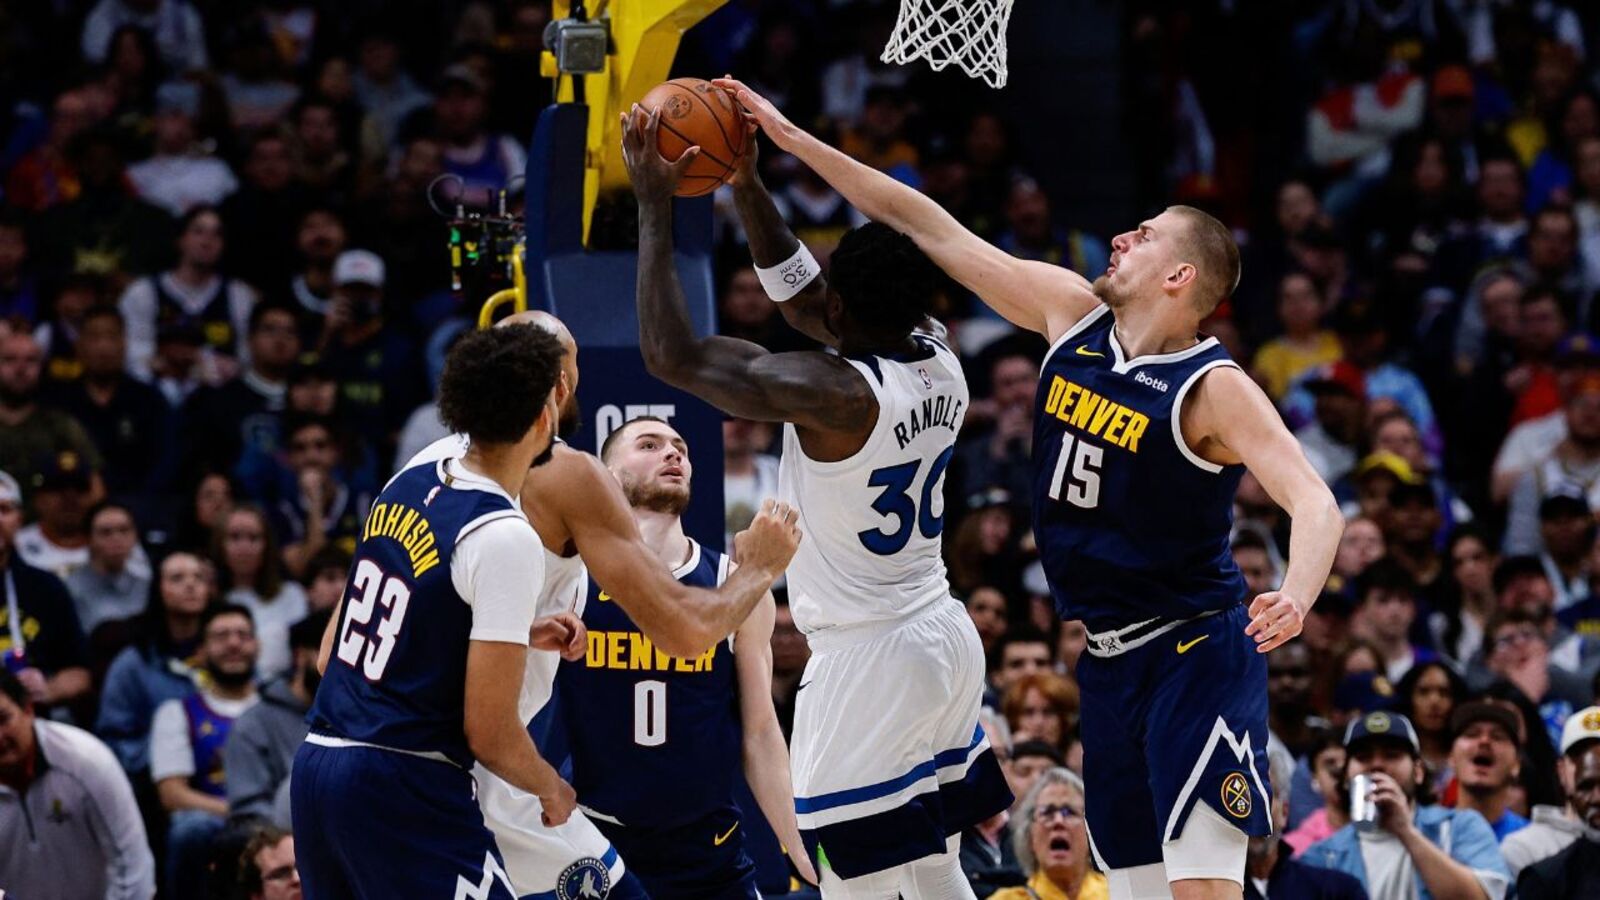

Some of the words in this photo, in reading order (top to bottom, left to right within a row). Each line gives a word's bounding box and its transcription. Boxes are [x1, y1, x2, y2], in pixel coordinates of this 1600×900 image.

[1045, 374, 1150, 453] DENVER
[1134, 370, 1169, 393] ibotta
[893, 395, 962, 450] RANDLE
[858, 444, 954, 556] 30
[1048, 431, 1104, 509] 15
[363, 503, 440, 578] JOHNSON
[337, 559, 411, 680] 23
[634, 679, 667, 747] 0
